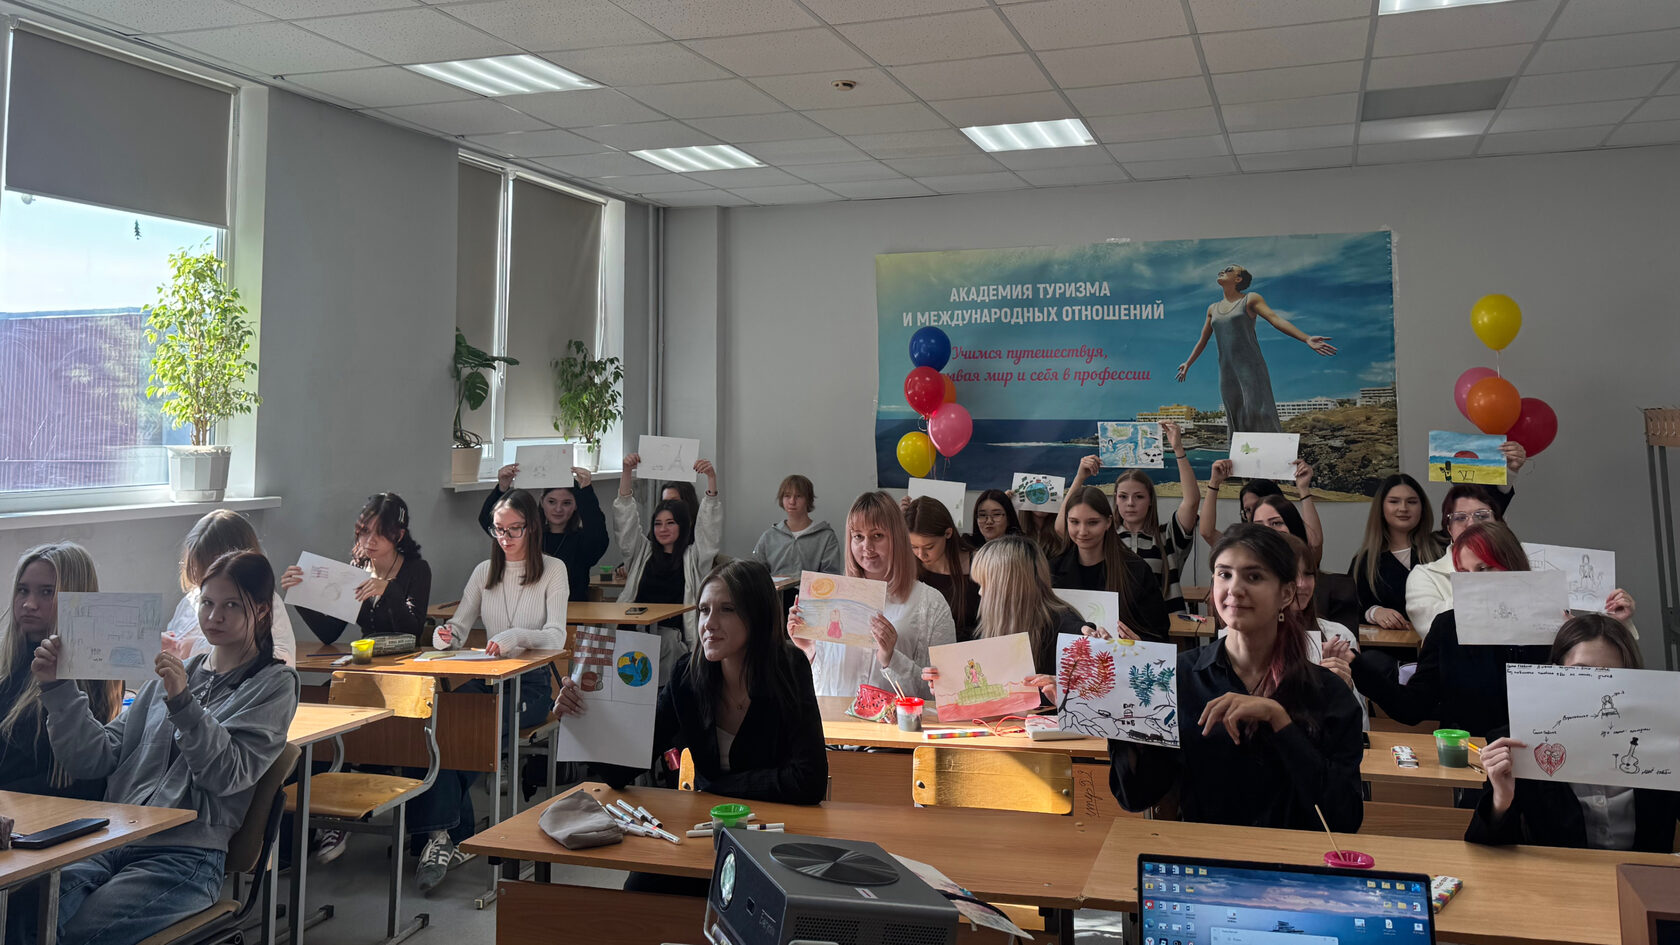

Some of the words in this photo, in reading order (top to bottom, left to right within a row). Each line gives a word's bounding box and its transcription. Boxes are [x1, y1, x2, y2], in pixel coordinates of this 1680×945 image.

[950, 284, 1032, 302] АКАДЕМИЯ
[1037, 281, 1111, 298] ТУРИЗМА
[903, 312, 912, 326] И
[917, 307, 1057, 326] МЕЖДУНАРОДНЫХ
[1062, 300, 1164, 321] ОТНОШЕНИЙ
[951, 346, 1002, 360] Учимся
[1007, 344, 1108, 365] путешествуя,
[984, 371, 1013, 387] мир
[1017, 372, 1026, 382] и
[1030, 368, 1058, 381] себя
[1063, 368, 1070, 380] в
[1074, 367, 1151, 387] профессии
